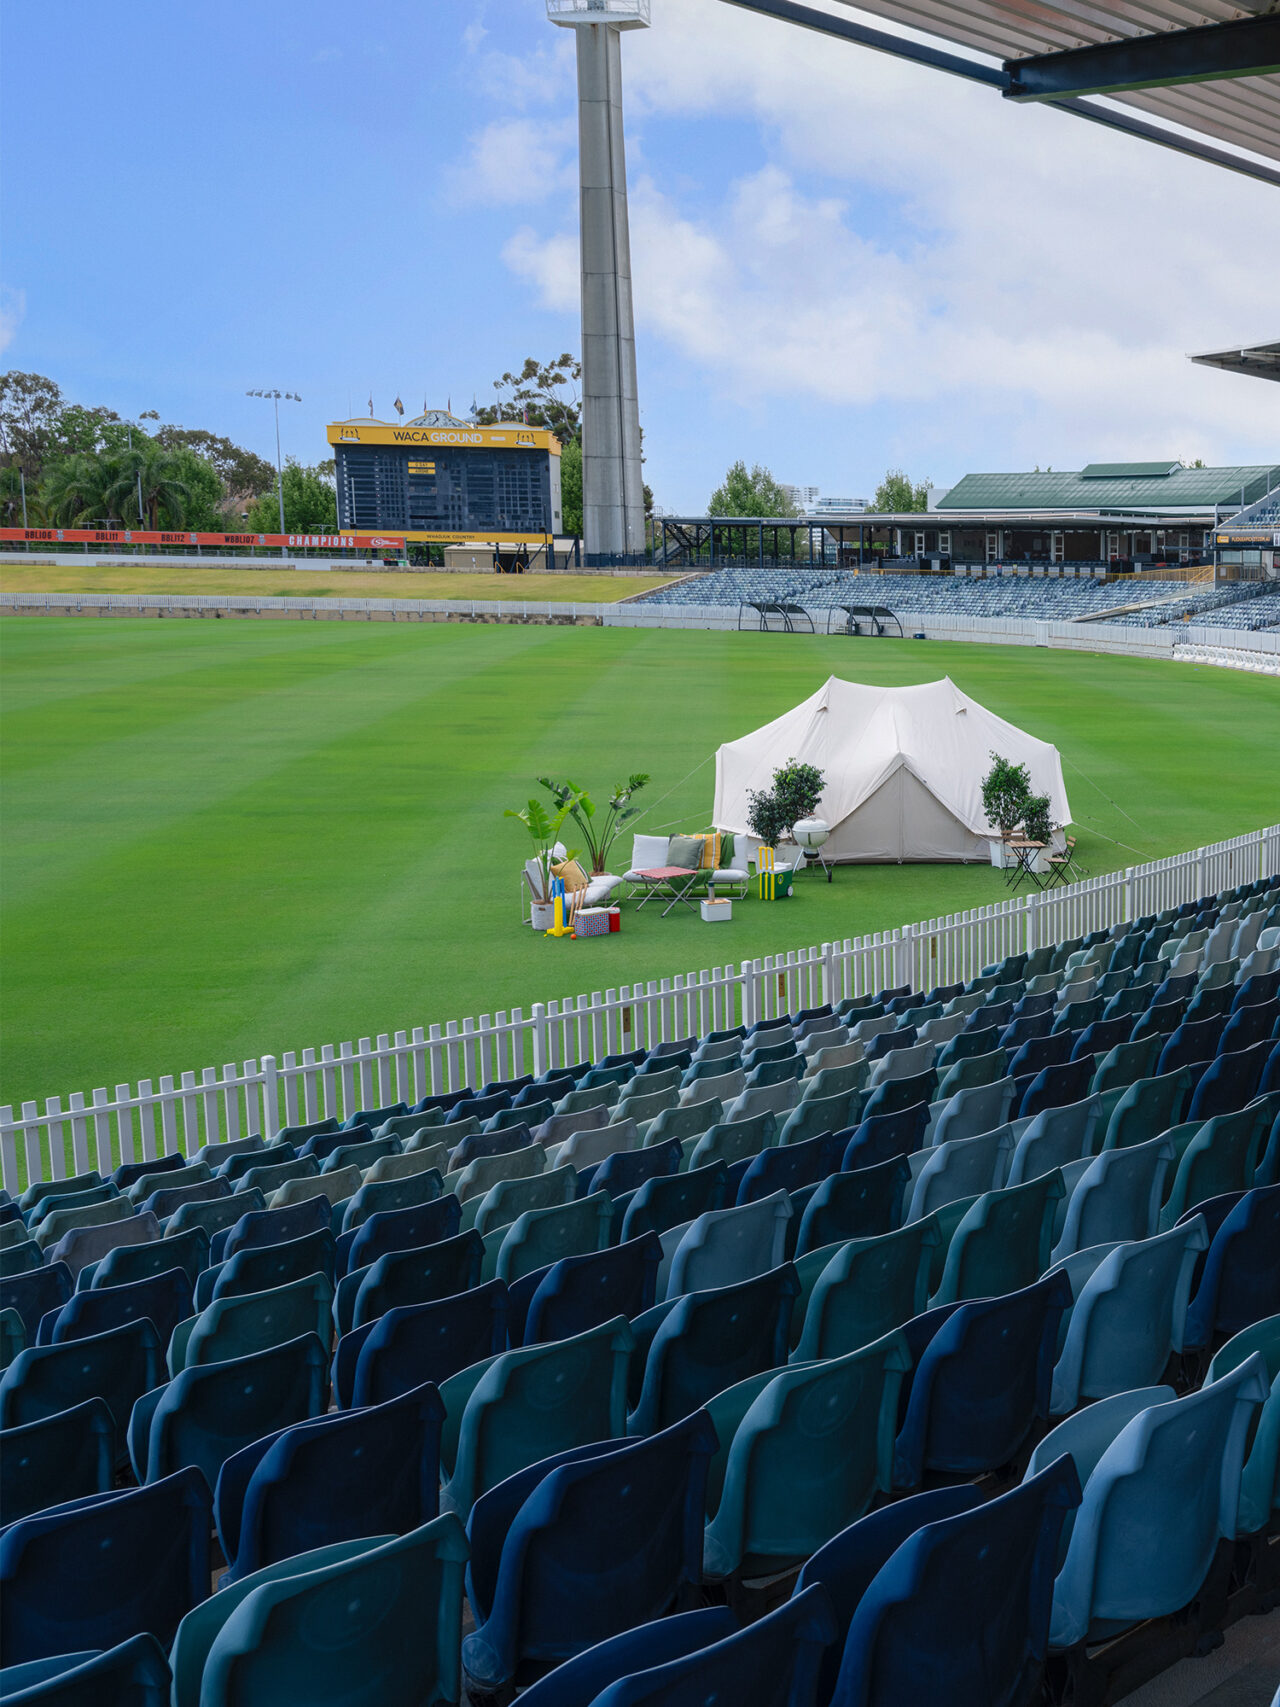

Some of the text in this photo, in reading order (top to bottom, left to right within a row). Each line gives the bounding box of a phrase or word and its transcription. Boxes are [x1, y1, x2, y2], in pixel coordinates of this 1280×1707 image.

[394, 432, 483, 443] WACA GROUND
[289, 536, 354, 546] CHAMPIONS
